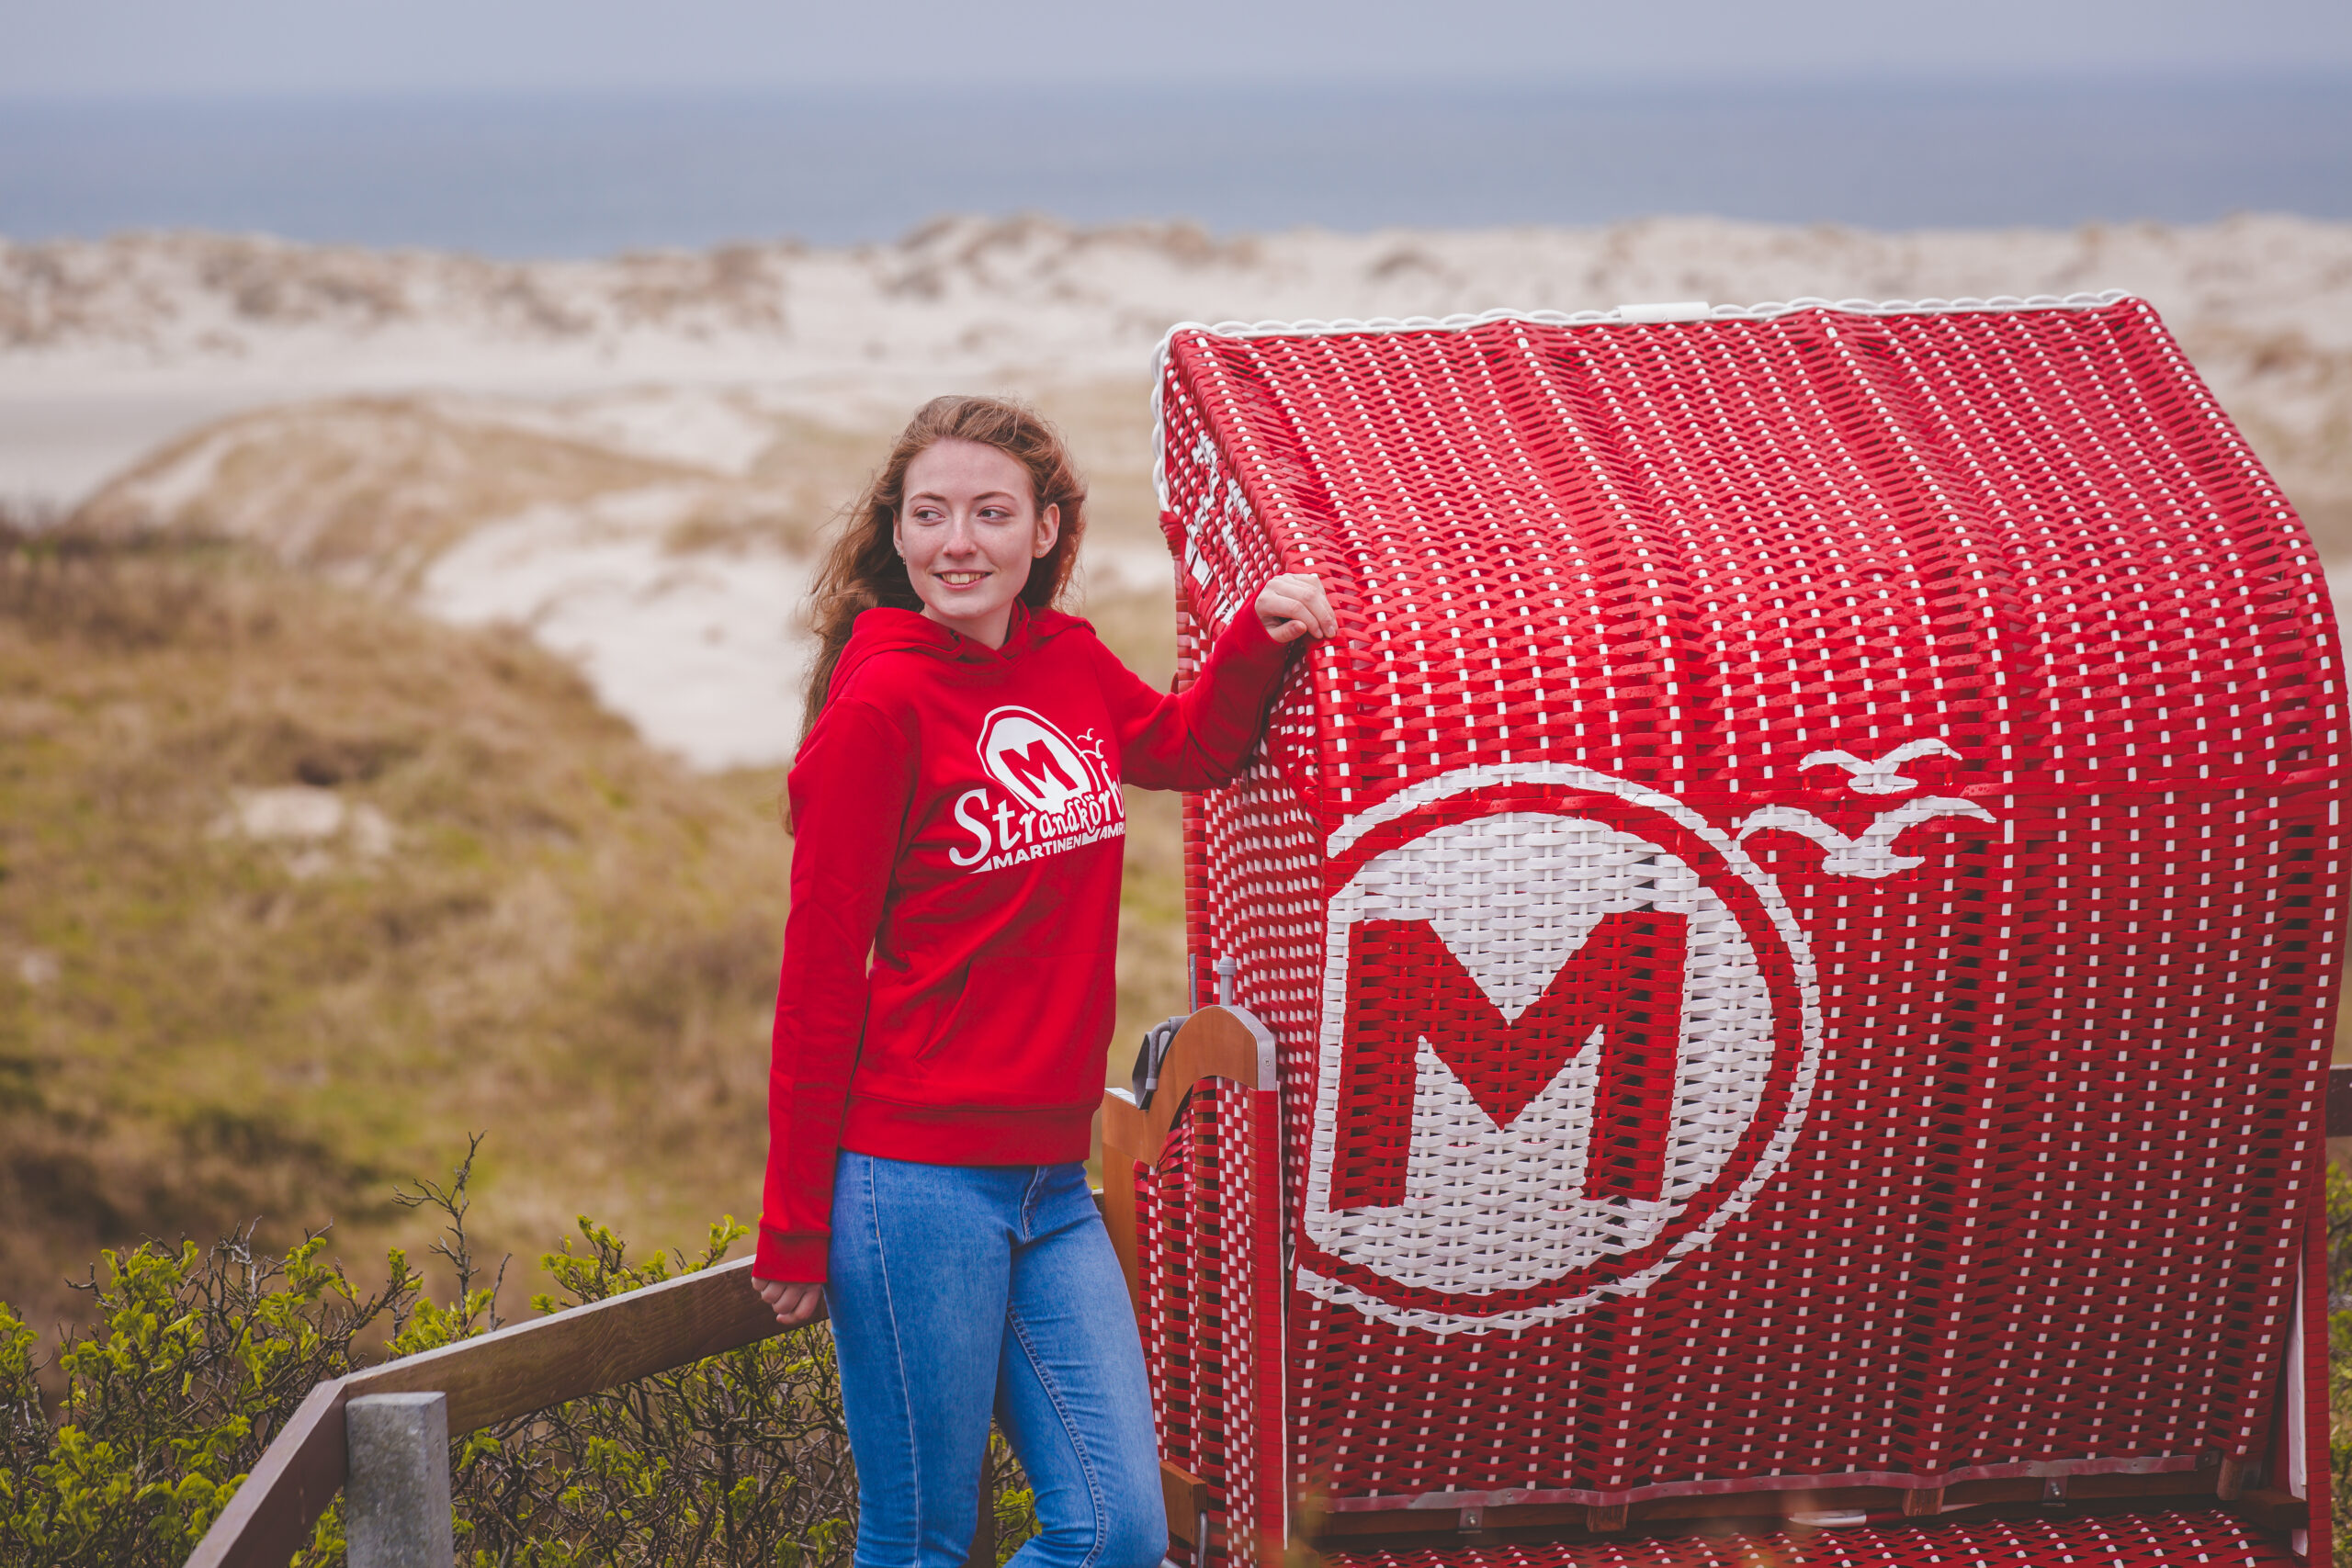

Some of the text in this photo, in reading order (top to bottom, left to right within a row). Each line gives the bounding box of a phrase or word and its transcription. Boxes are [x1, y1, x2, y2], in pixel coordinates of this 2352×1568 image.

[999, 739, 1079, 799] M
[948, 760, 1125, 866] Strandkörb
[993, 821, 1125, 870] MARTINEN AMR
[1329, 911, 1688, 1211] M
